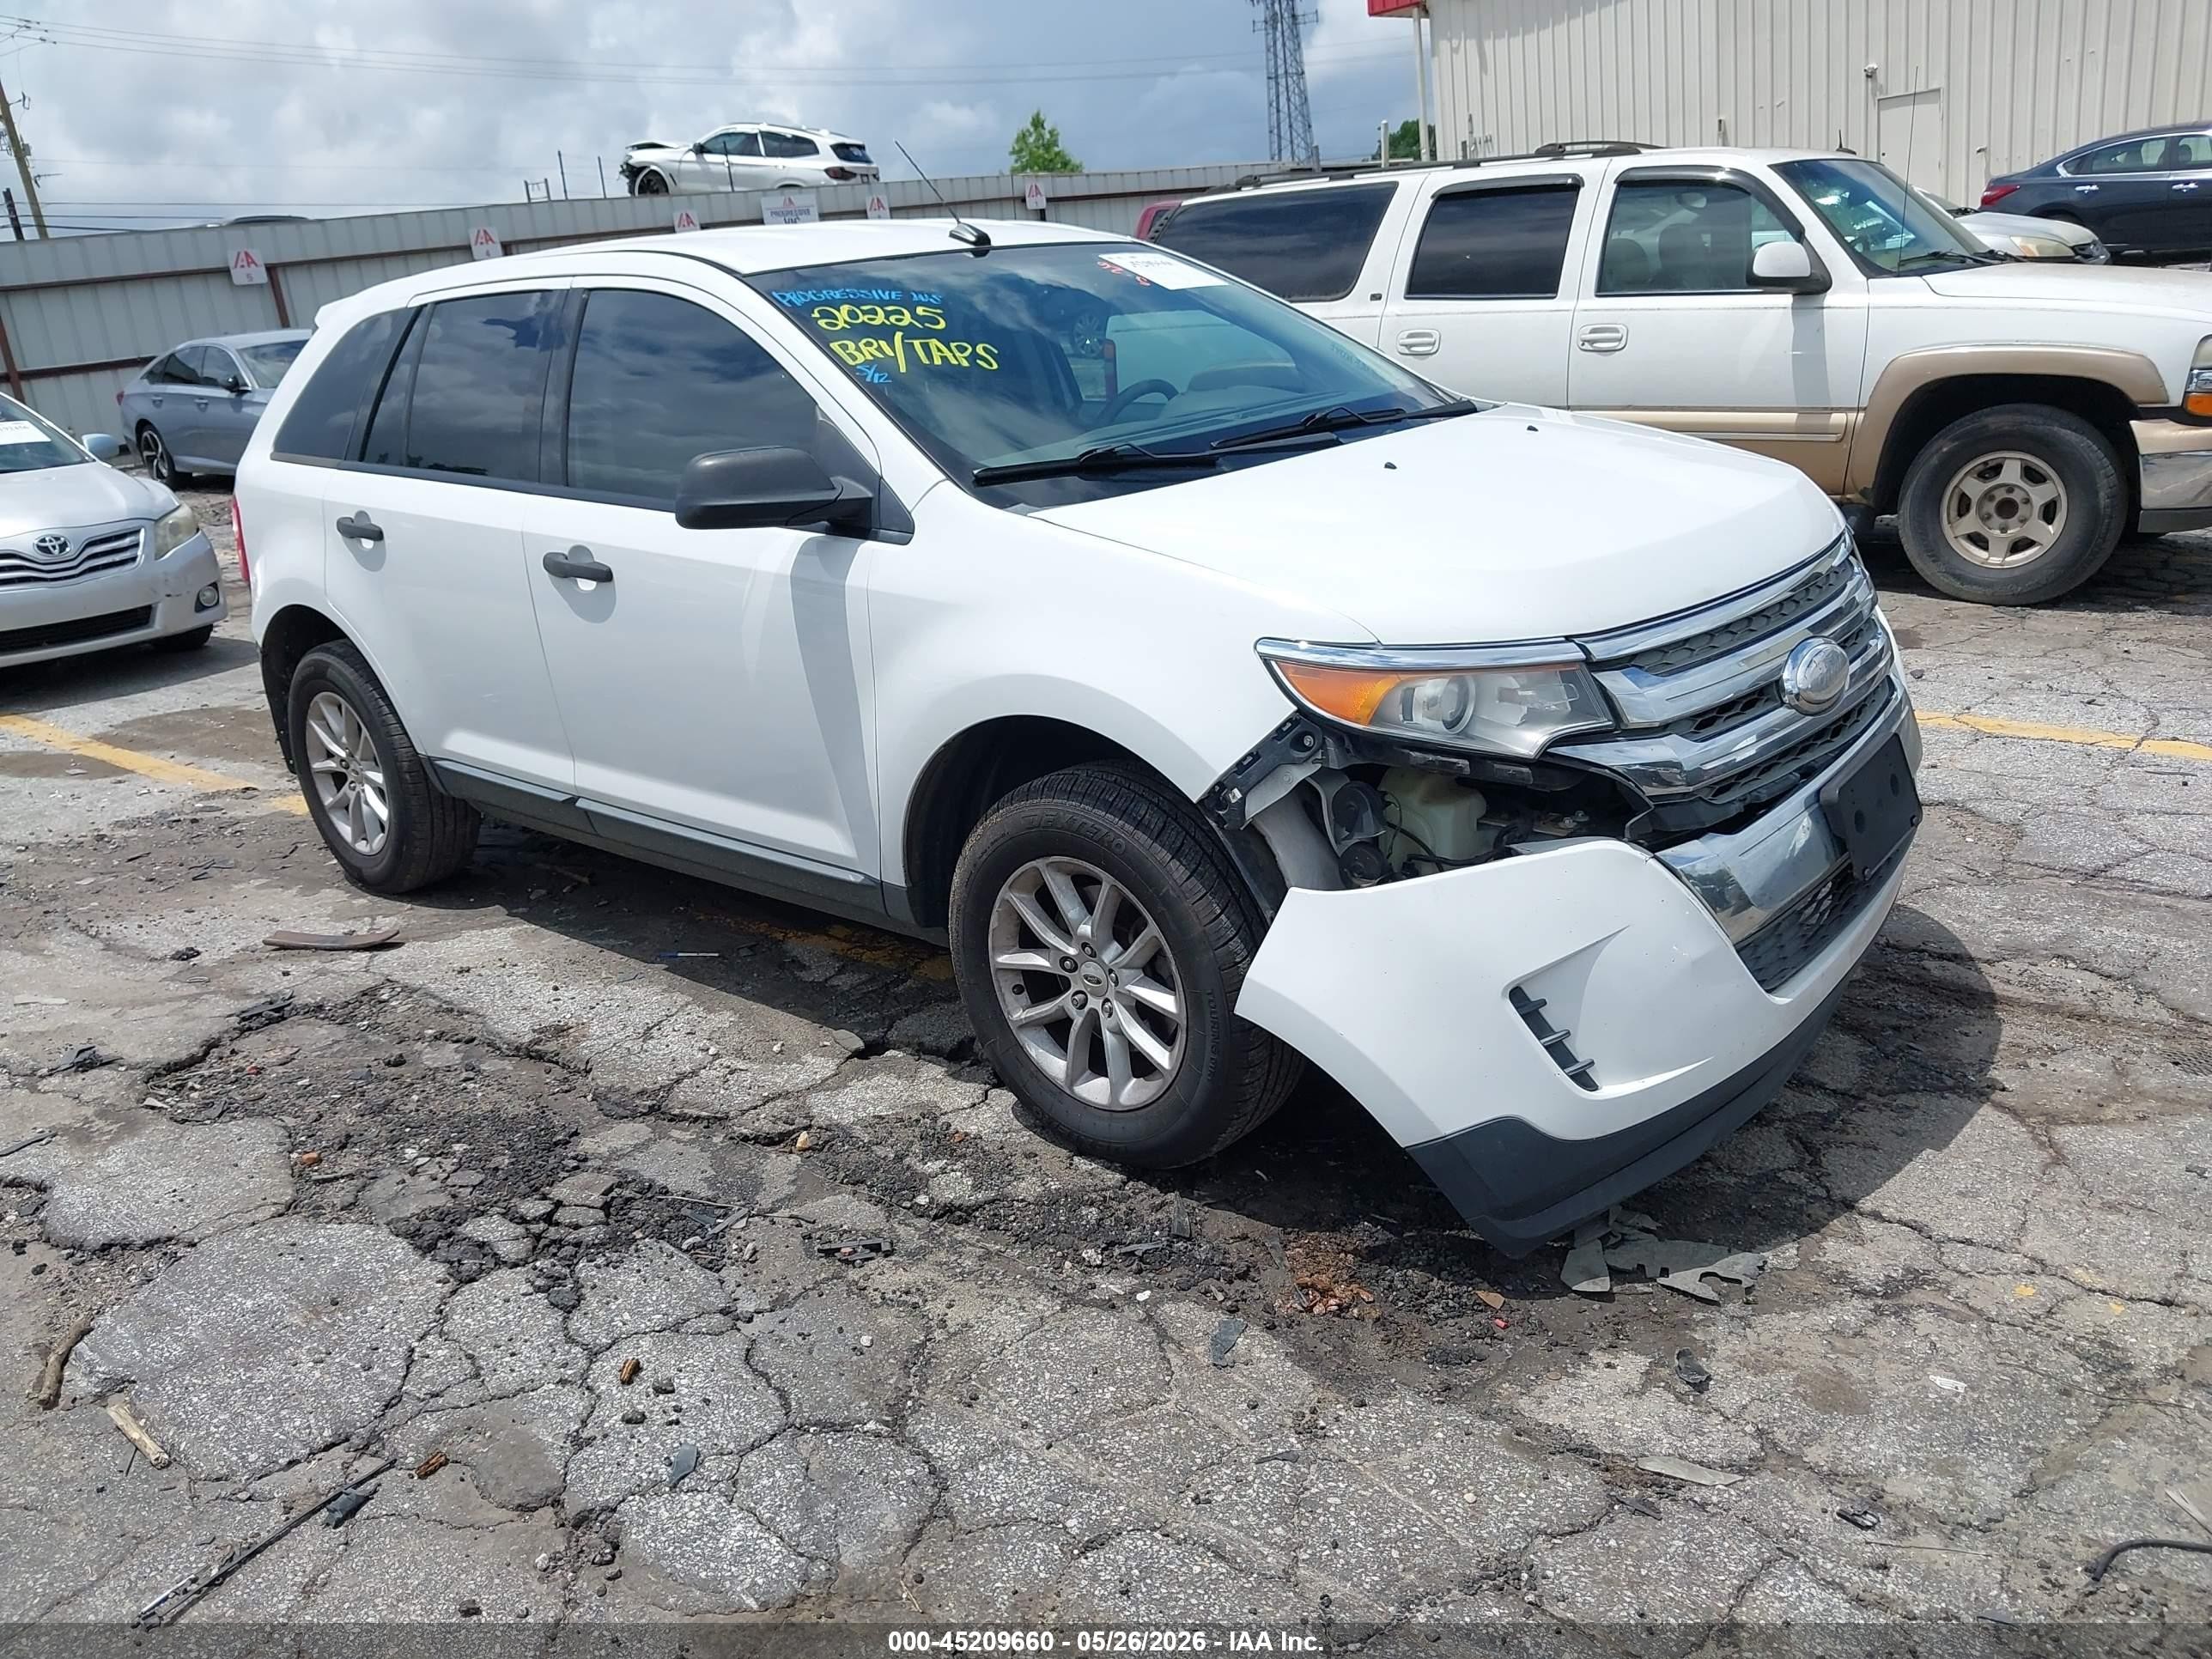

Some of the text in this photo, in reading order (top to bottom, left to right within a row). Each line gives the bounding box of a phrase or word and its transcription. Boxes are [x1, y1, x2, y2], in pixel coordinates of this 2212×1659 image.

[772, 289, 902, 307] PROGRESSIVE
[811, 304, 946, 331] 20225
[830, 331, 1000, 374] BRI/TAPS
